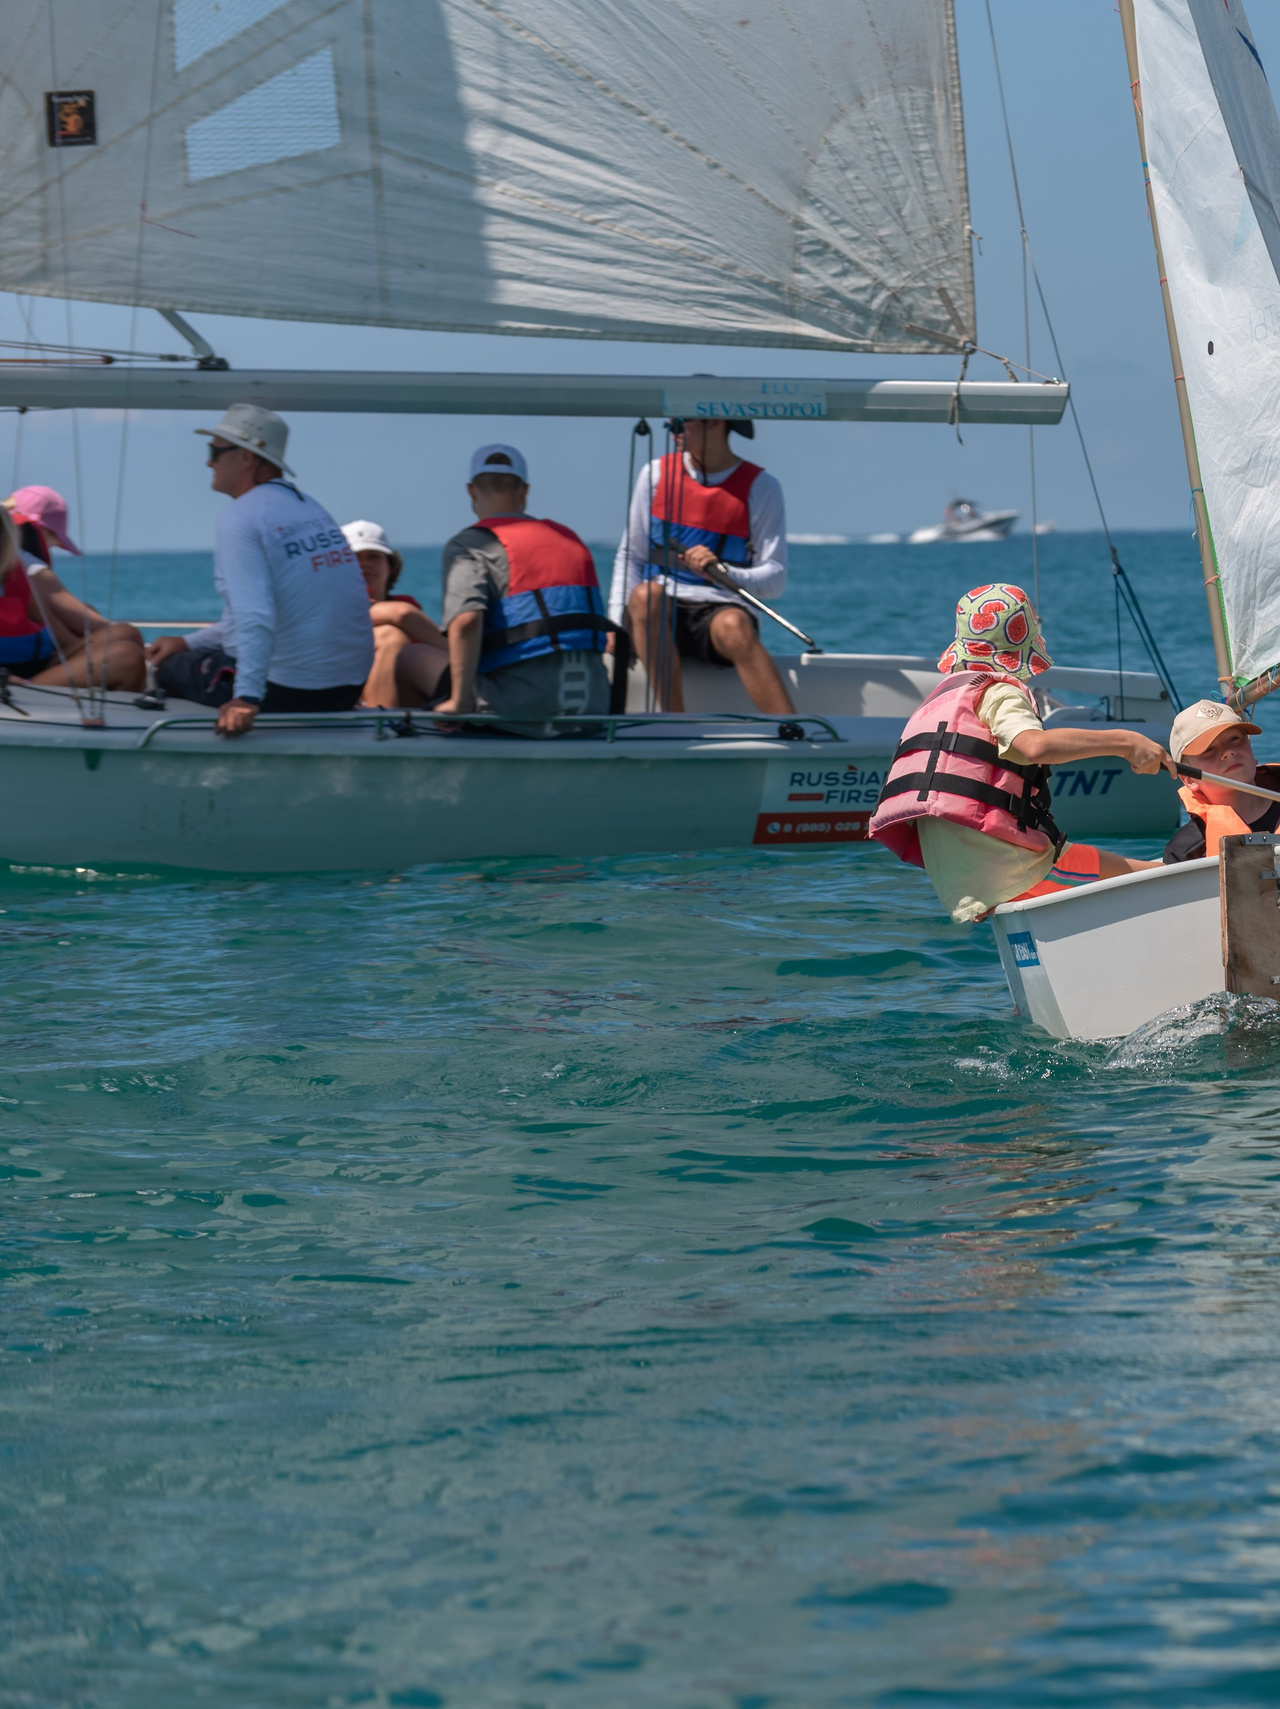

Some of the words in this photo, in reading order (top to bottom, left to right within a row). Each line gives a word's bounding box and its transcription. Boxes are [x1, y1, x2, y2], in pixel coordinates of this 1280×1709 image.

[696, 401, 828, 417] SEVASTOPOL
[789, 771, 888, 787] RUSSIA
[1053, 769, 1123, 797] TNT
